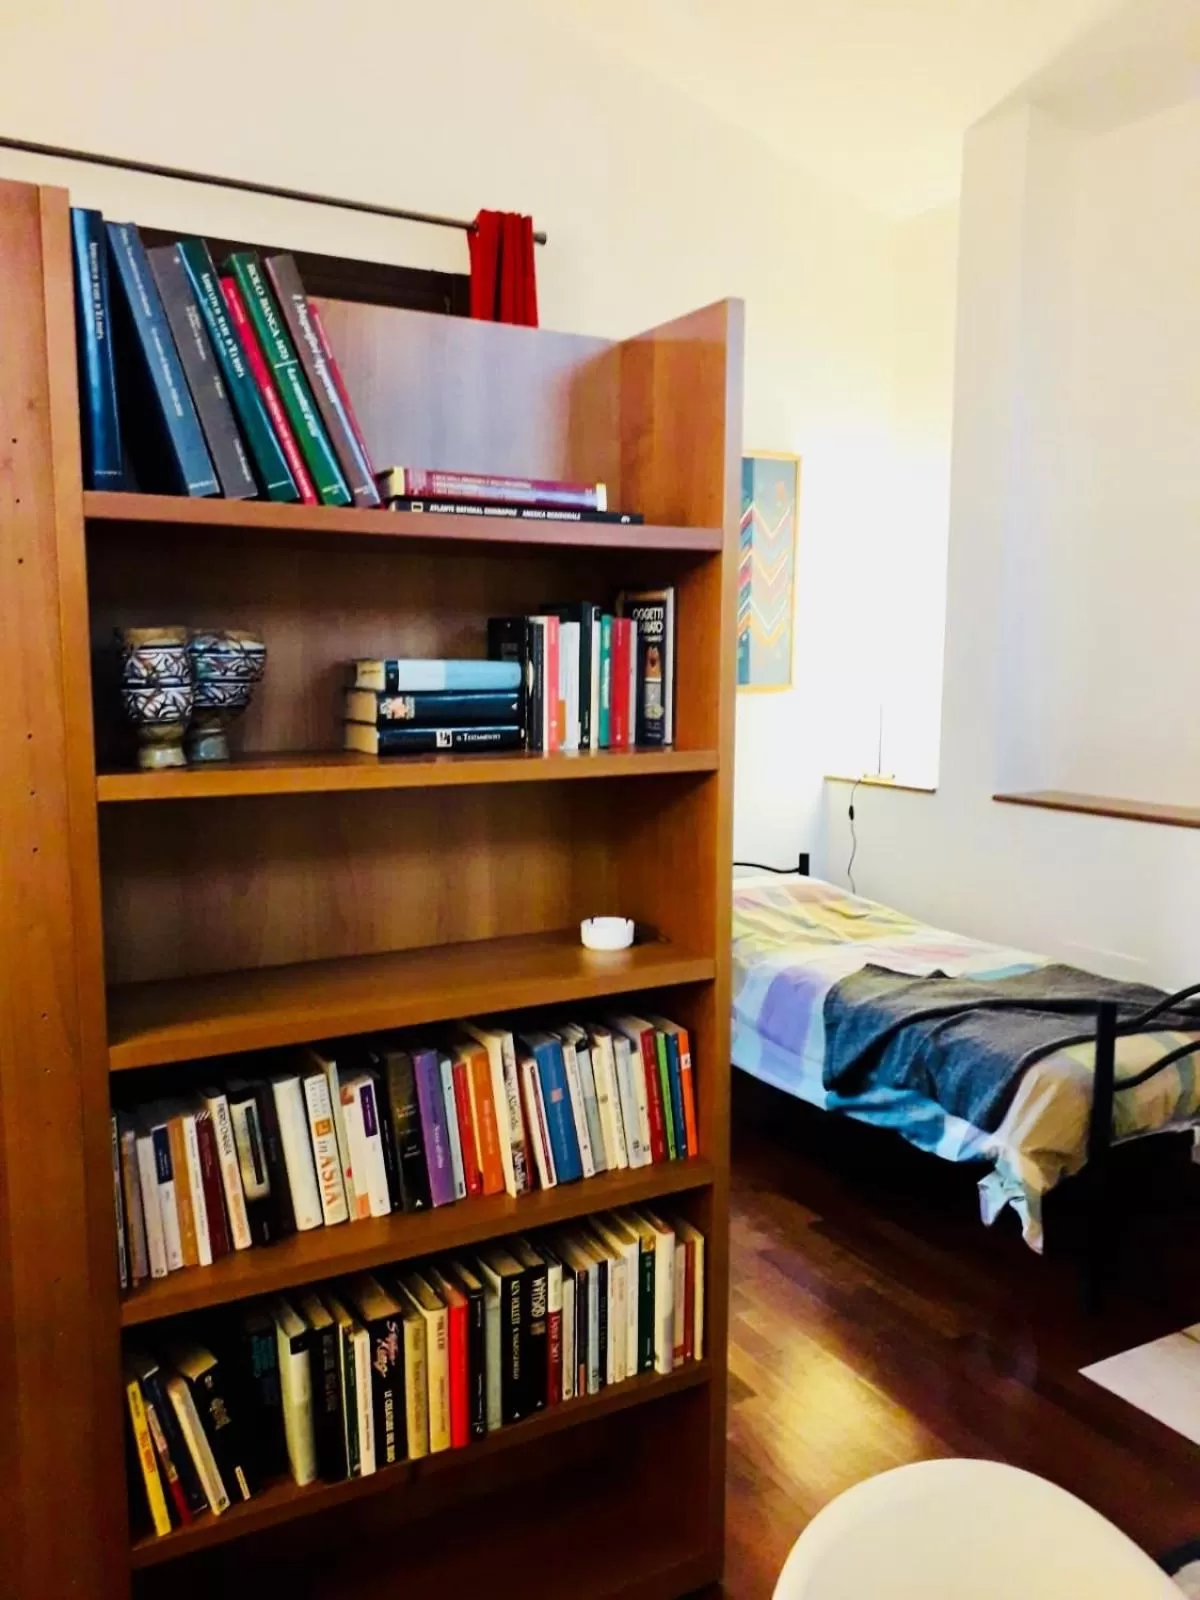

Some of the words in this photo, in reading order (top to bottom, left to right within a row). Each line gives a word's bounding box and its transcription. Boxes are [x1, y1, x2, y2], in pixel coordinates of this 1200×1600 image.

[257, 296, 282, 337] BANCA
[429, 504, 454, 513] ATLANTE
[633, 607, 664, 620] OGGETTI
[319, 1155, 340, 1206] ASIA
